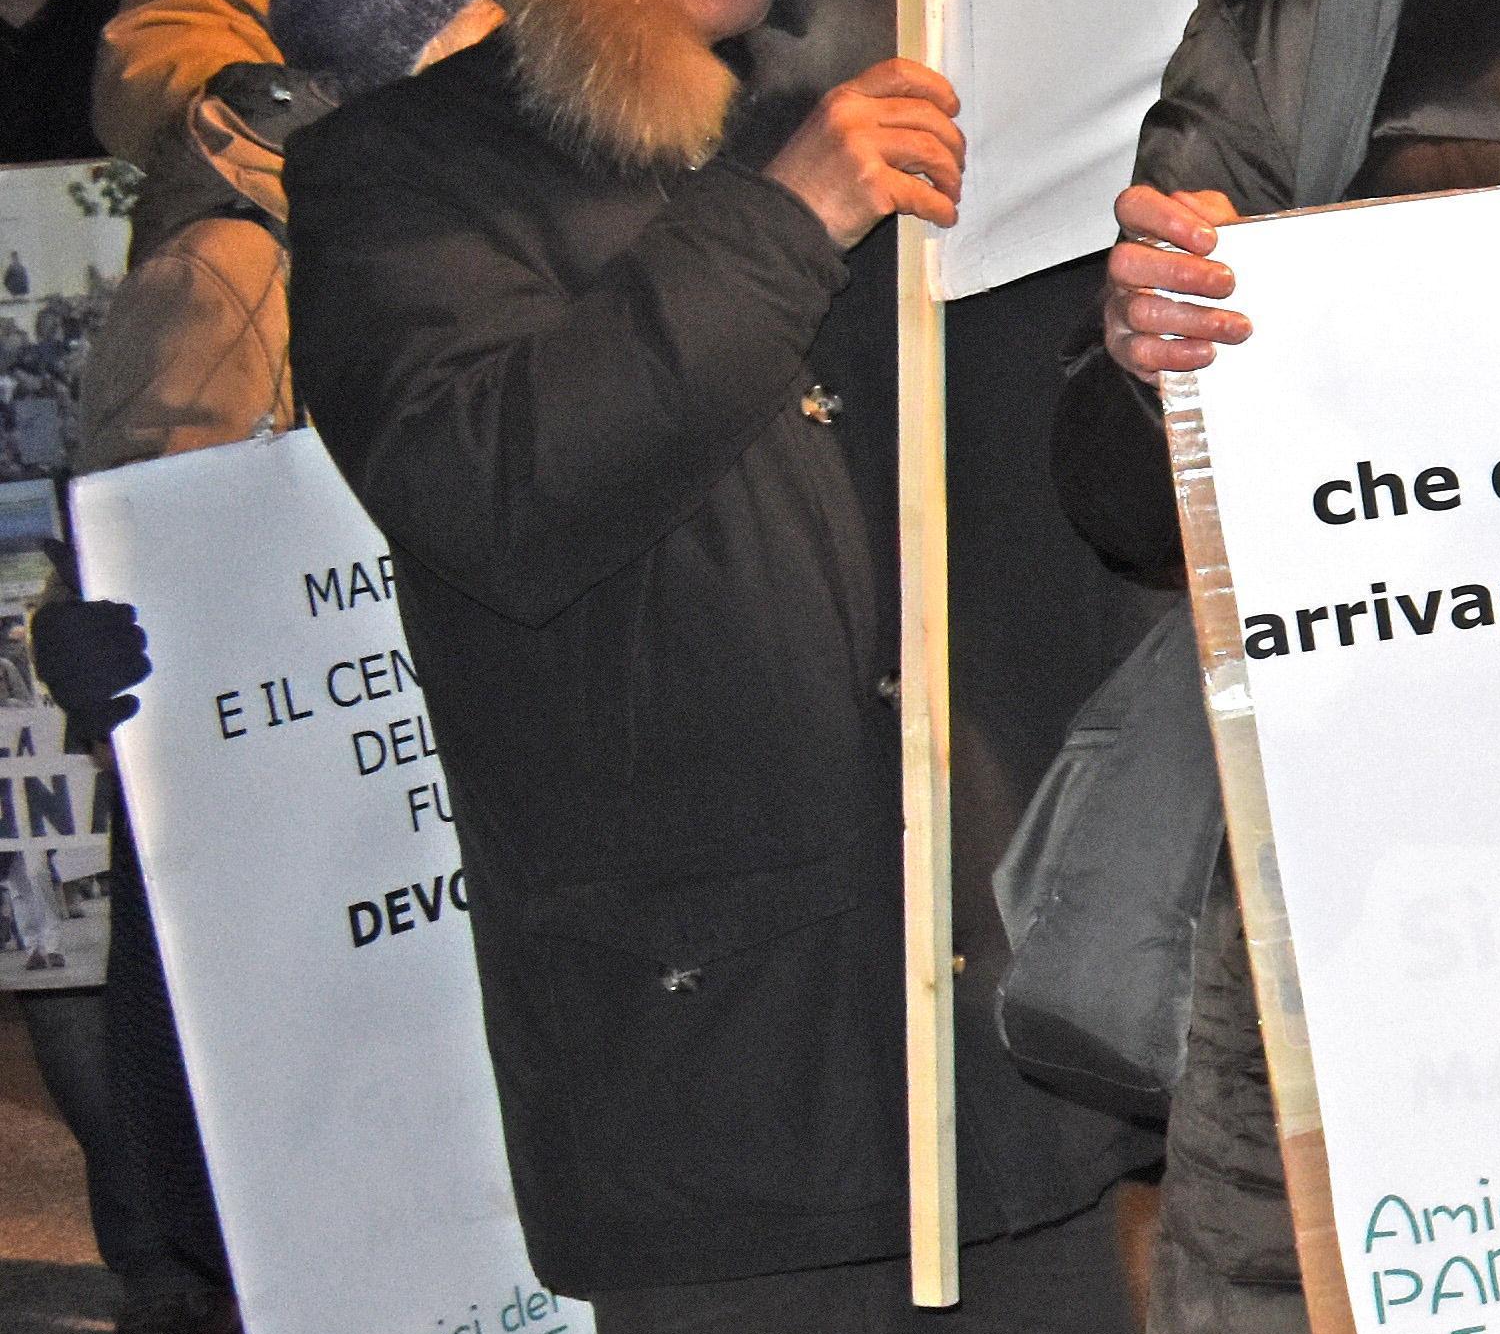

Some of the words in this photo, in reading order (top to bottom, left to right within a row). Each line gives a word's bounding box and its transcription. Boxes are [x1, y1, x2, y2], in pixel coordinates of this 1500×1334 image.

[1311, 465, 1460, 528] che
[216, 691, 247, 740] E
[260, 678, 313, 727] IL
